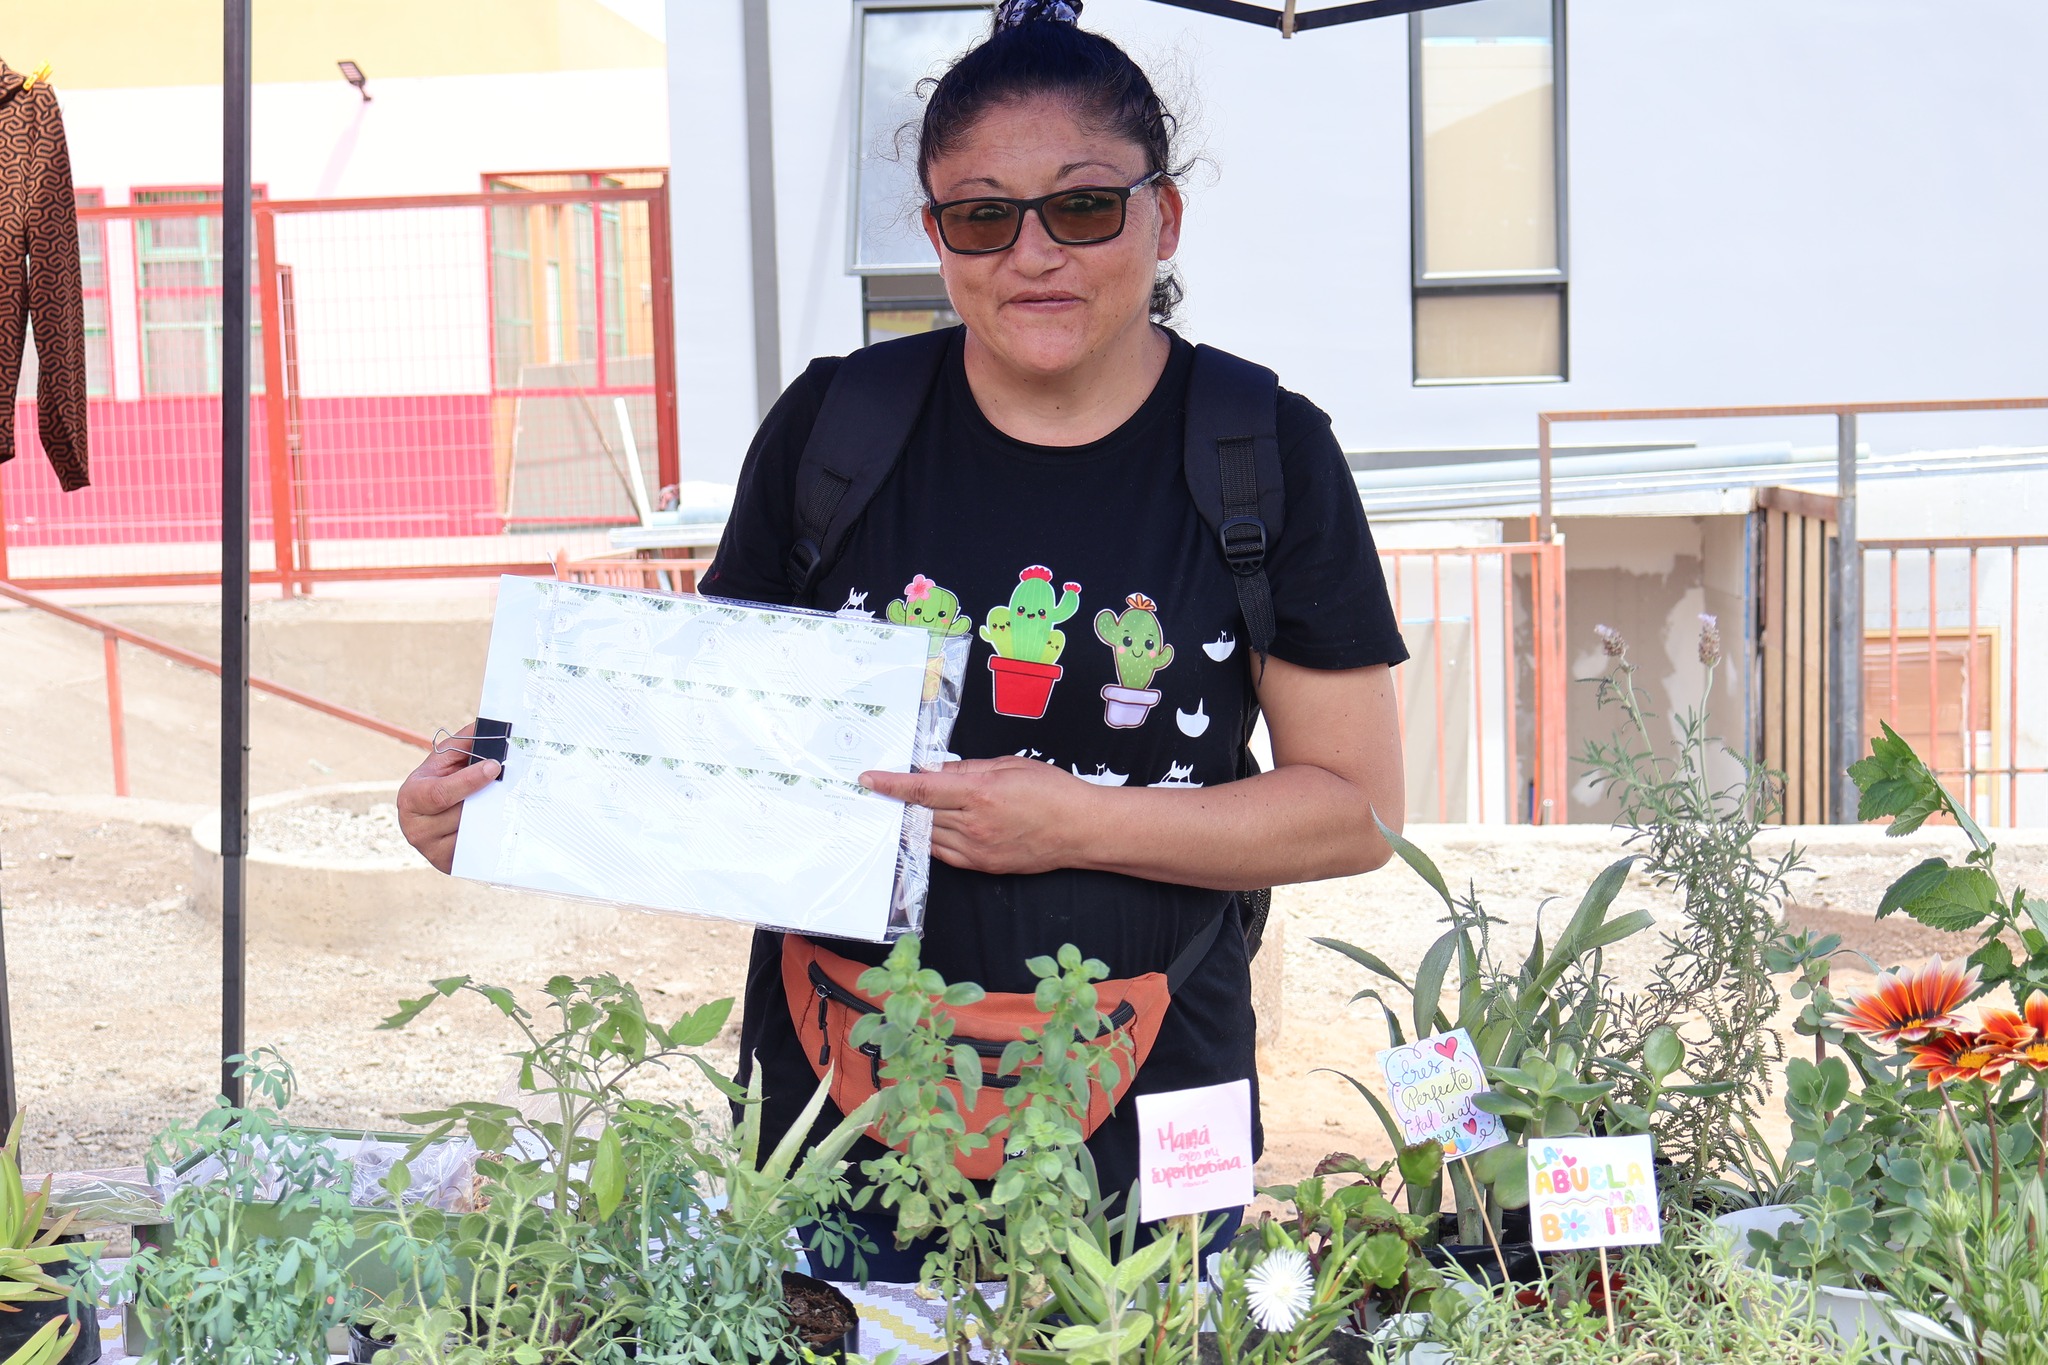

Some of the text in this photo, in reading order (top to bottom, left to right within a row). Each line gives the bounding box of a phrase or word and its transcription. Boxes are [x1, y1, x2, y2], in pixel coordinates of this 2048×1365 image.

[1401, 1060, 1443, 1085] Eres
[1414, 1096, 1477, 1137] tal cual
[1530, 1147, 1559, 1170] LA
[1535, 1162, 1645, 1195] ABUELA
